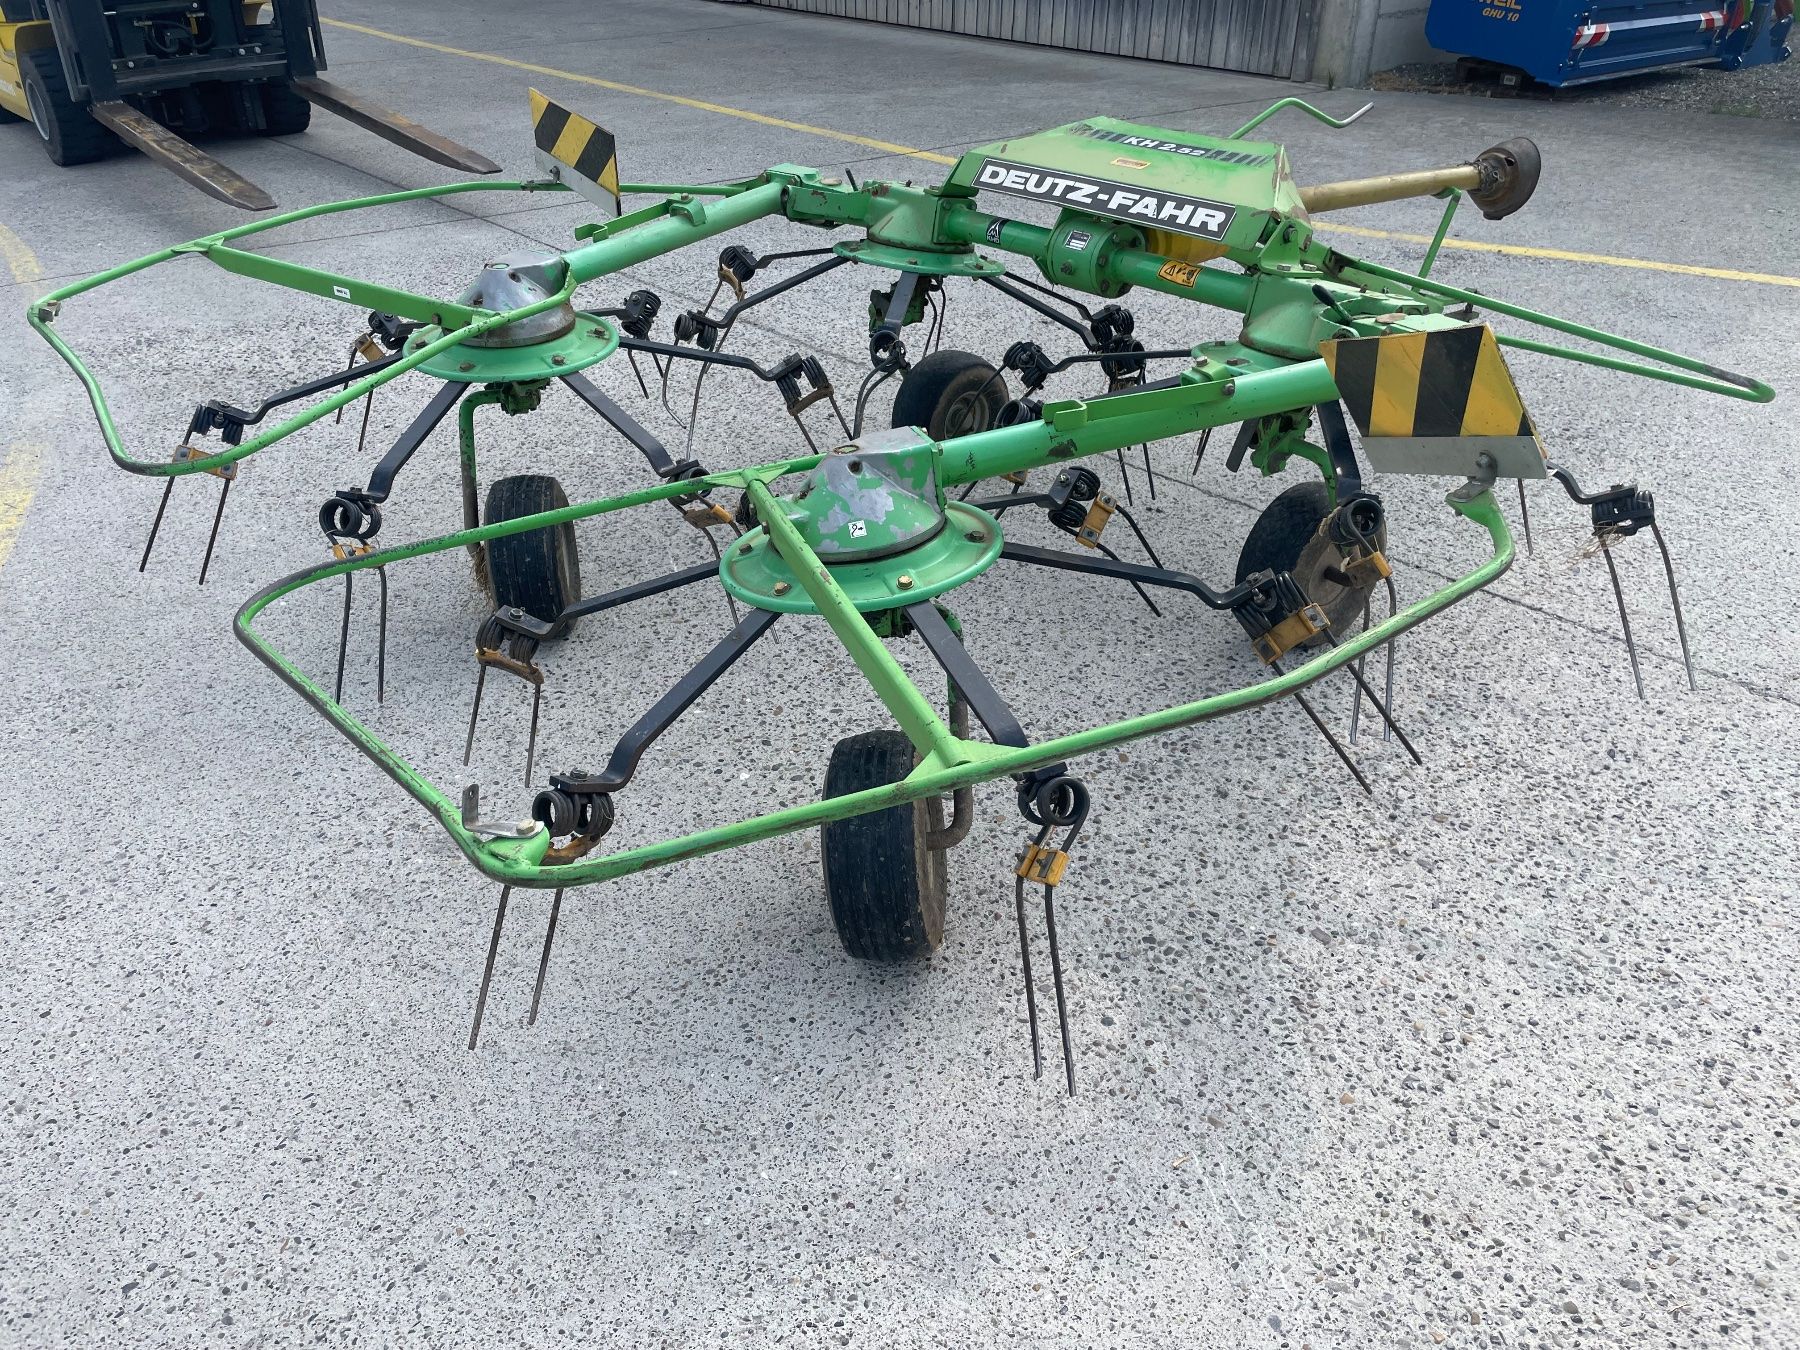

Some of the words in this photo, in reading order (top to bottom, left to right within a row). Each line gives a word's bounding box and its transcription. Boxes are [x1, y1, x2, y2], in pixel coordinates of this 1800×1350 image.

[1482, 8, 1505, 19] GHU
[1507, 12, 1520, 22] 10
[1123, 136, 1160, 148] KH
[1157, 143, 1206, 157] 2.52
[979, 164, 1227, 233] DEUTZ-FAHR
